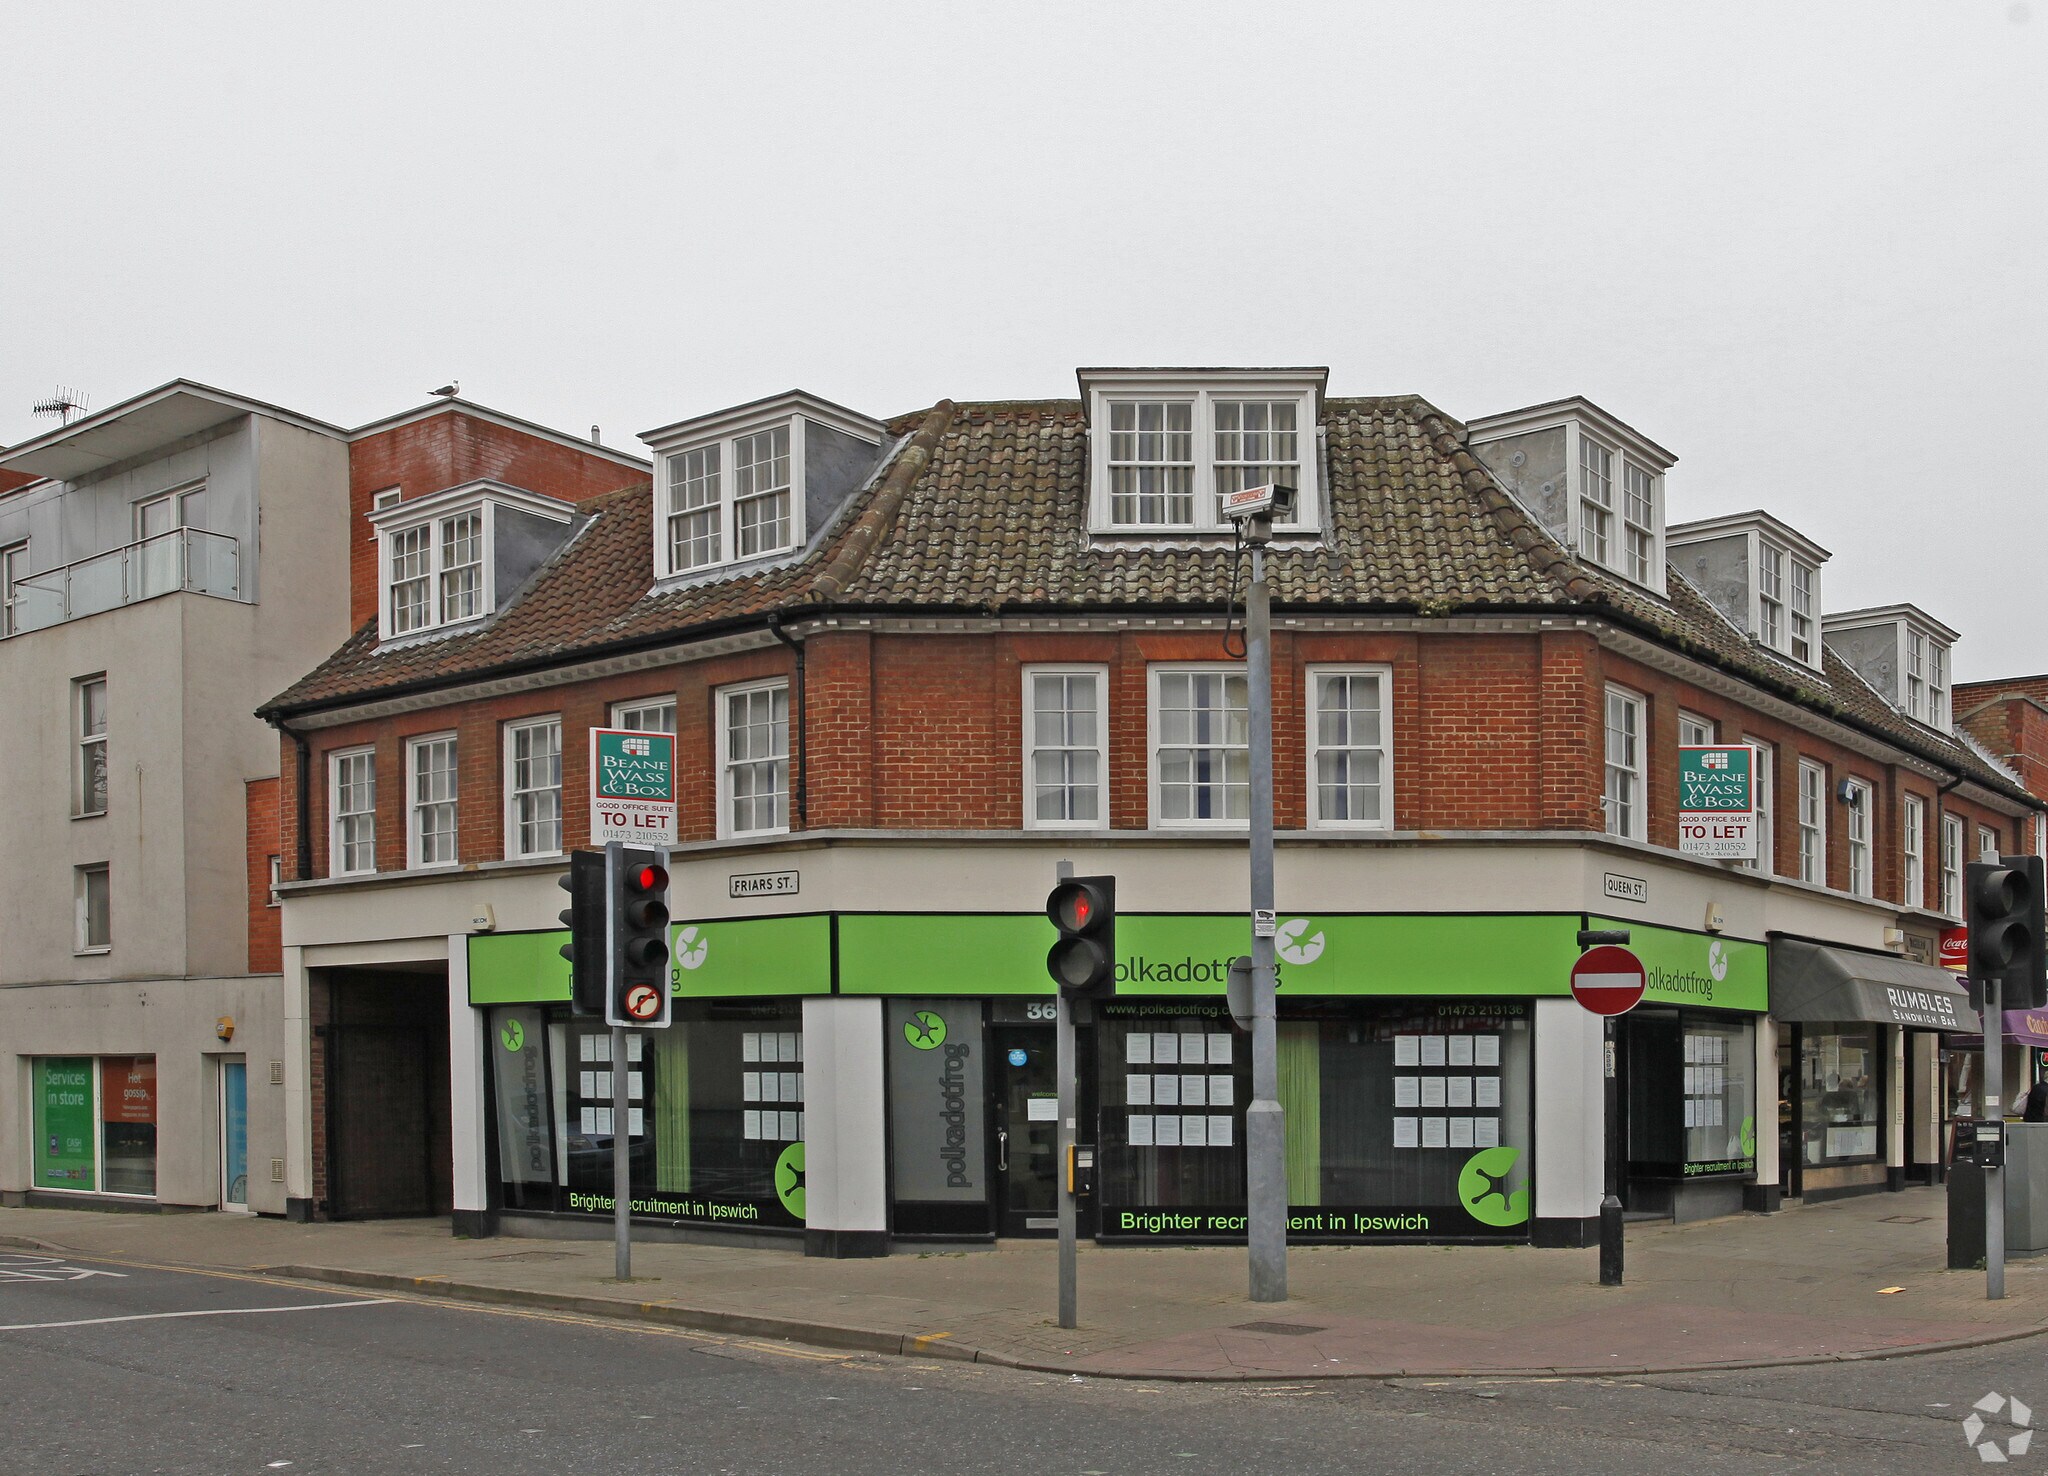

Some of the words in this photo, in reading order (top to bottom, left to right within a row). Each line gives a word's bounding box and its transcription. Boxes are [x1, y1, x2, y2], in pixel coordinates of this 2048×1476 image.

[602, 755, 669, 771] BEANE
[606, 768, 665, 783] WASS
[1683, 770, 1746, 782] BEANE
[602, 779, 624, 794] &
[624, 782, 668, 797] BOX
[1686, 783, 1743, 795] WASS
[596, 801, 619, 809] GOOD
[622, 803, 649, 811] OFFICE
[651, 805, 674, 813] SUITE
[1683, 793, 1702, 808] &
[1704, 796, 1746, 807] BOX
[601, 812, 627, 826] TO
[634, 813, 669, 829] LET
[602, 829, 632, 839] 01473
[635, 831, 669, 841] 210552
[1681, 825, 1707, 839] TO
[1713, 825, 1747, 839] LET
[1682, 842, 1711, 851] 01473
[1714, 842, 1747, 851] 210552
[734, 878, 773, 892] FRIARS
[777, 876, 793, 890] ST.
[1607, 879, 1632, 895] QUEEN
[1633, 884, 1644, 897] ST.
[1113, 956, 1283, 989] olkadotfg
[1647, 966, 1714, 1001] olkadotfrog
[1886, 987, 1954, 1014] RUMBLES
[1027, 1002, 1058, 1020] 36
[1105, 1003, 1229, 1018] www.polkadotfrog.c
[1438, 1005, 1476, 1016] 01473
[1893, 1009, 1938, 1024] SANDWICH
[1941, 1015, 1958, 1027] BAR
[46, 1069, 86, 1086] Services
[127, 1072, 142, 1084] Hot
[48, 1089, 57, 1105] in
[59, 1090, 84, 1106] store
[939, 1043, 973, 1188] polkadotfrog
[1684, 1163, 1704, 1175] Brighter
[569, 1192, 616, 1212] Brighter
[629, 1197, 690, 1215] cruitment
[693, 1201, 703, 1216] in
[708, 1201, 758, 1221] Ipswich
[1120, 1212, 1202, 1233] Brighter
[1207, 1213, 1323, 1230] recrent
[1329, 1213, 1346, 1230] in
[1354, 1213, 1429, 1234] Ipswich
